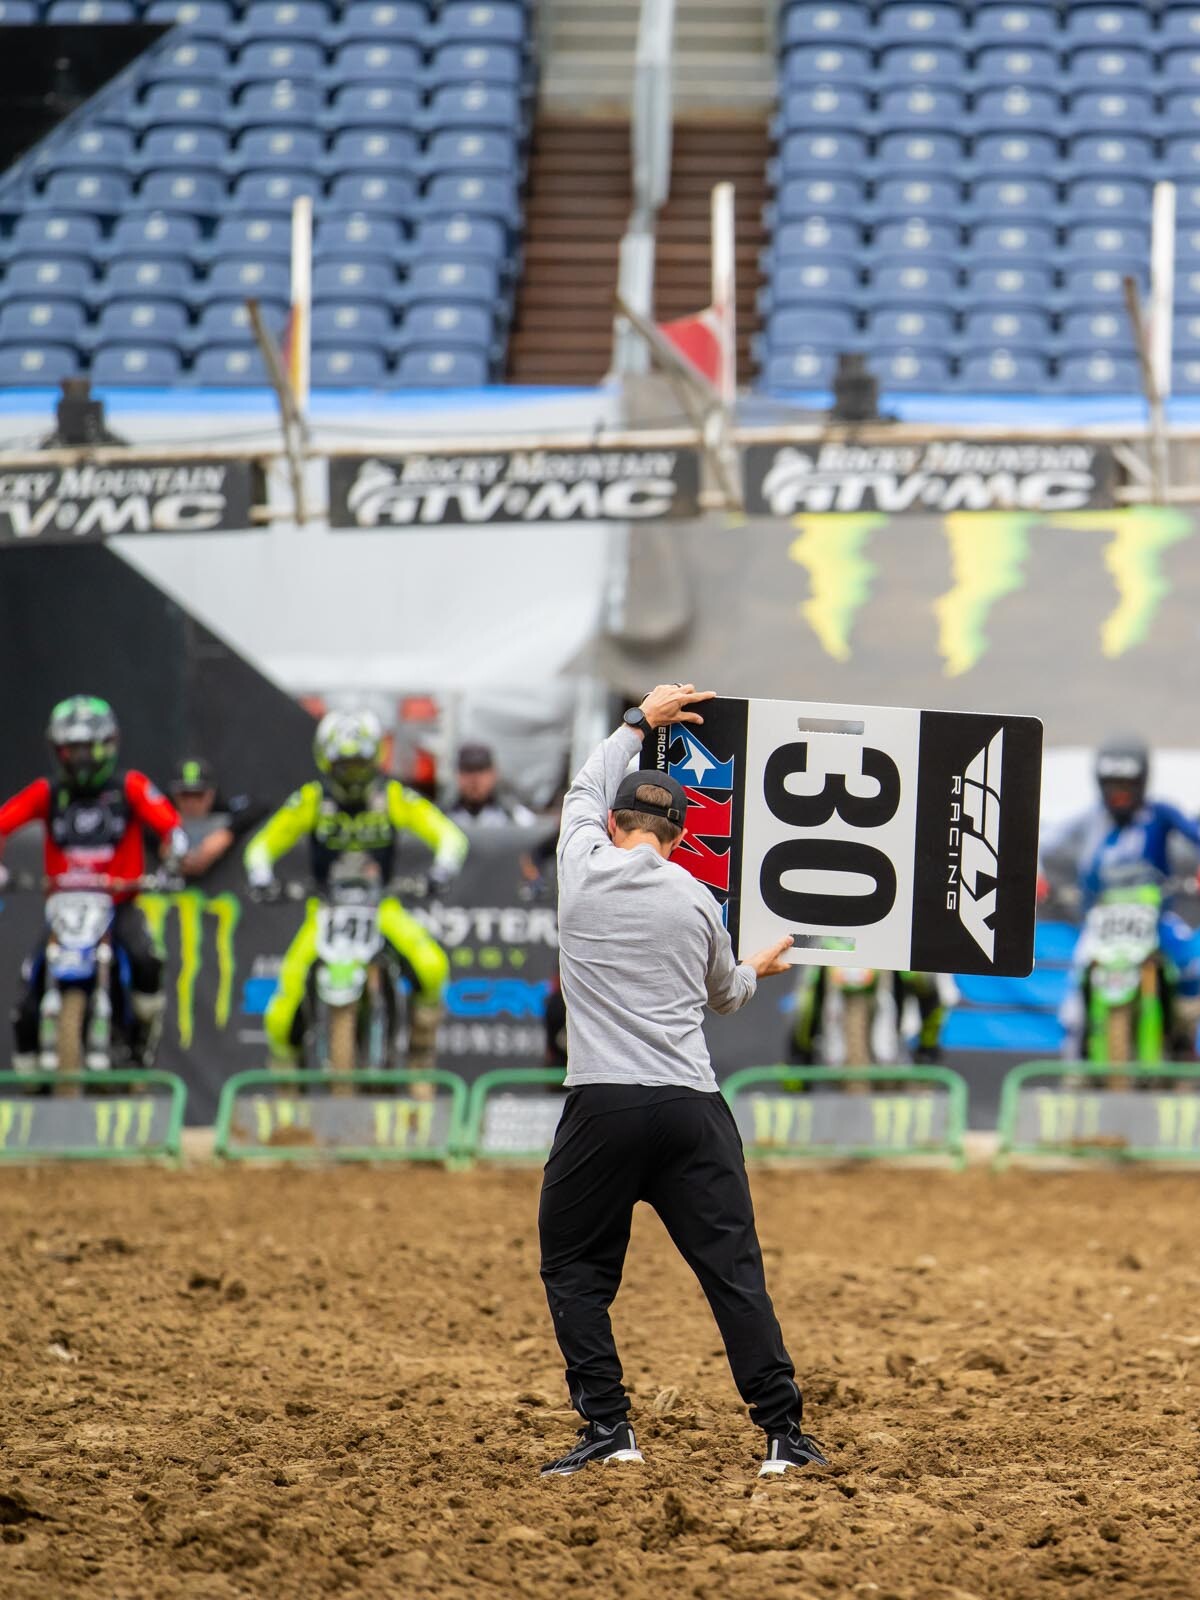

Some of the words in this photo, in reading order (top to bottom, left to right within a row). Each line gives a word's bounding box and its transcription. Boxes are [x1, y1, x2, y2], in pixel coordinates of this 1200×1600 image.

[656, 726, 667, 770] ERICAN
[667, 722, 735, 930] AM
[759, 740, 902, 928] 30
[946, 775, 962, 911] RACING
[958, 727, 1004, 964] FLY
